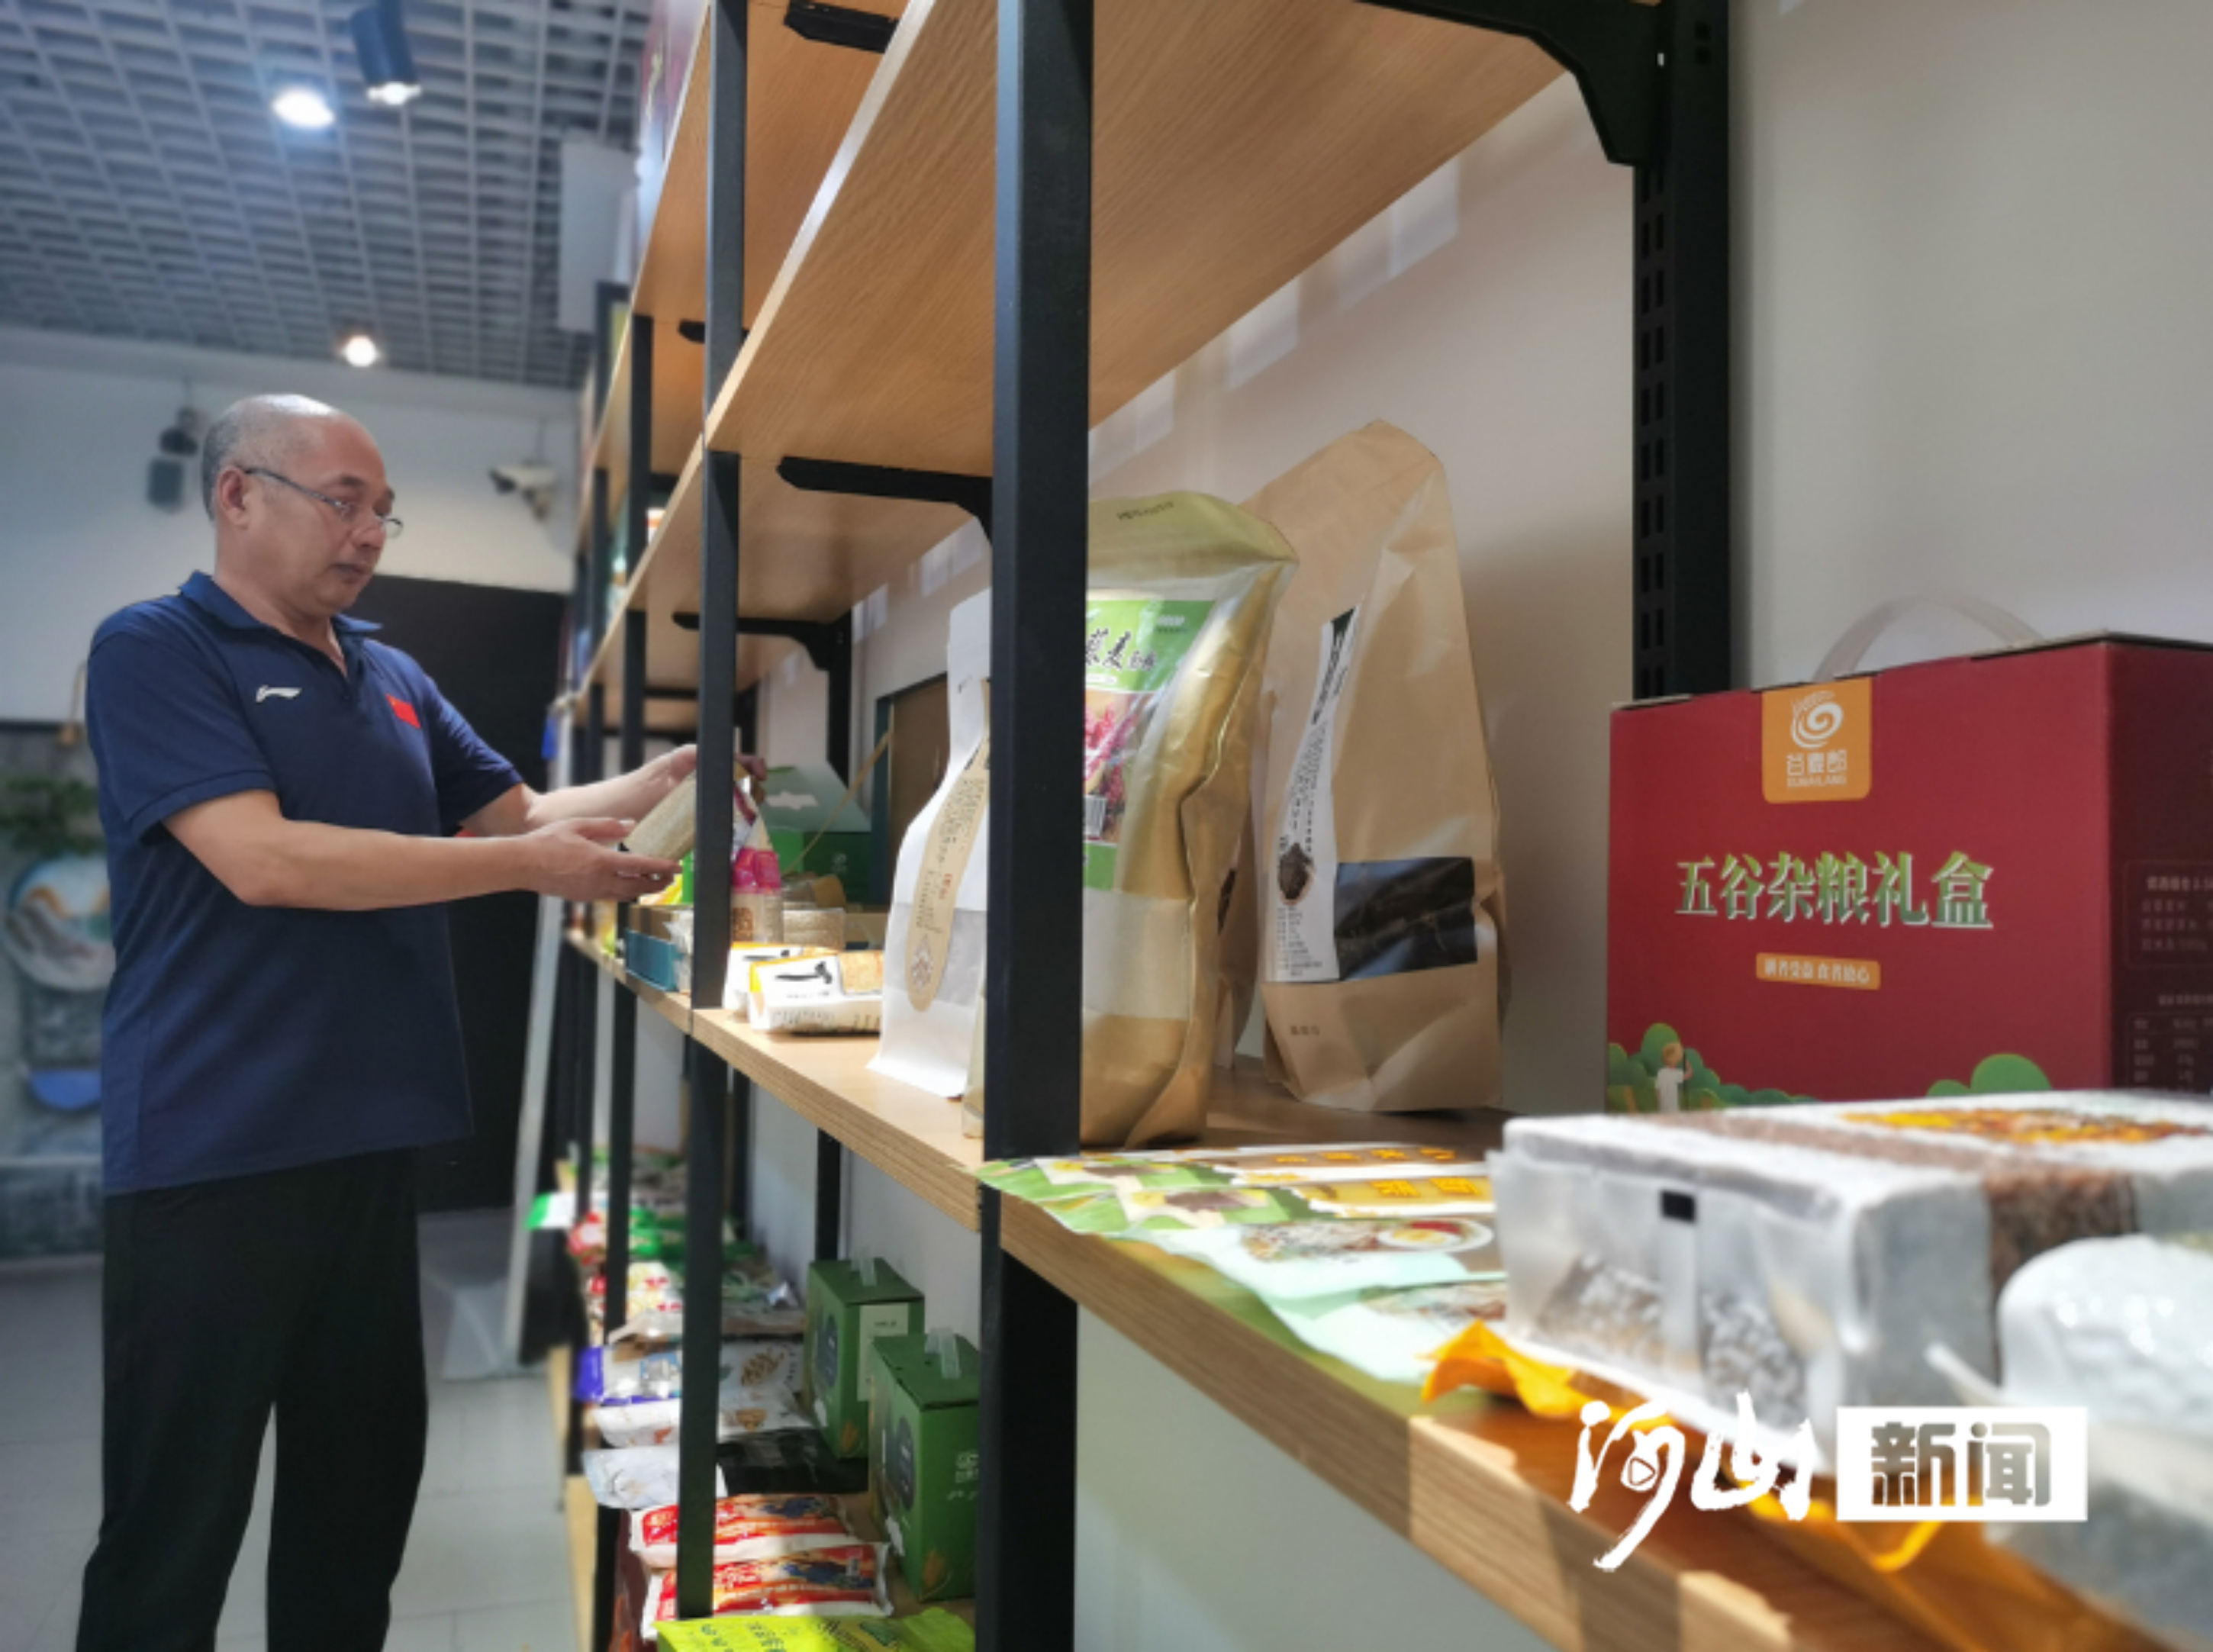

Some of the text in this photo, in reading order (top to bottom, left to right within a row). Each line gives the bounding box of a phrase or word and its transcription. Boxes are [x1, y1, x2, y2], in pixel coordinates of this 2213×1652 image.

[1675, 850, 1994, 929] 五谷杂粮礼盒
